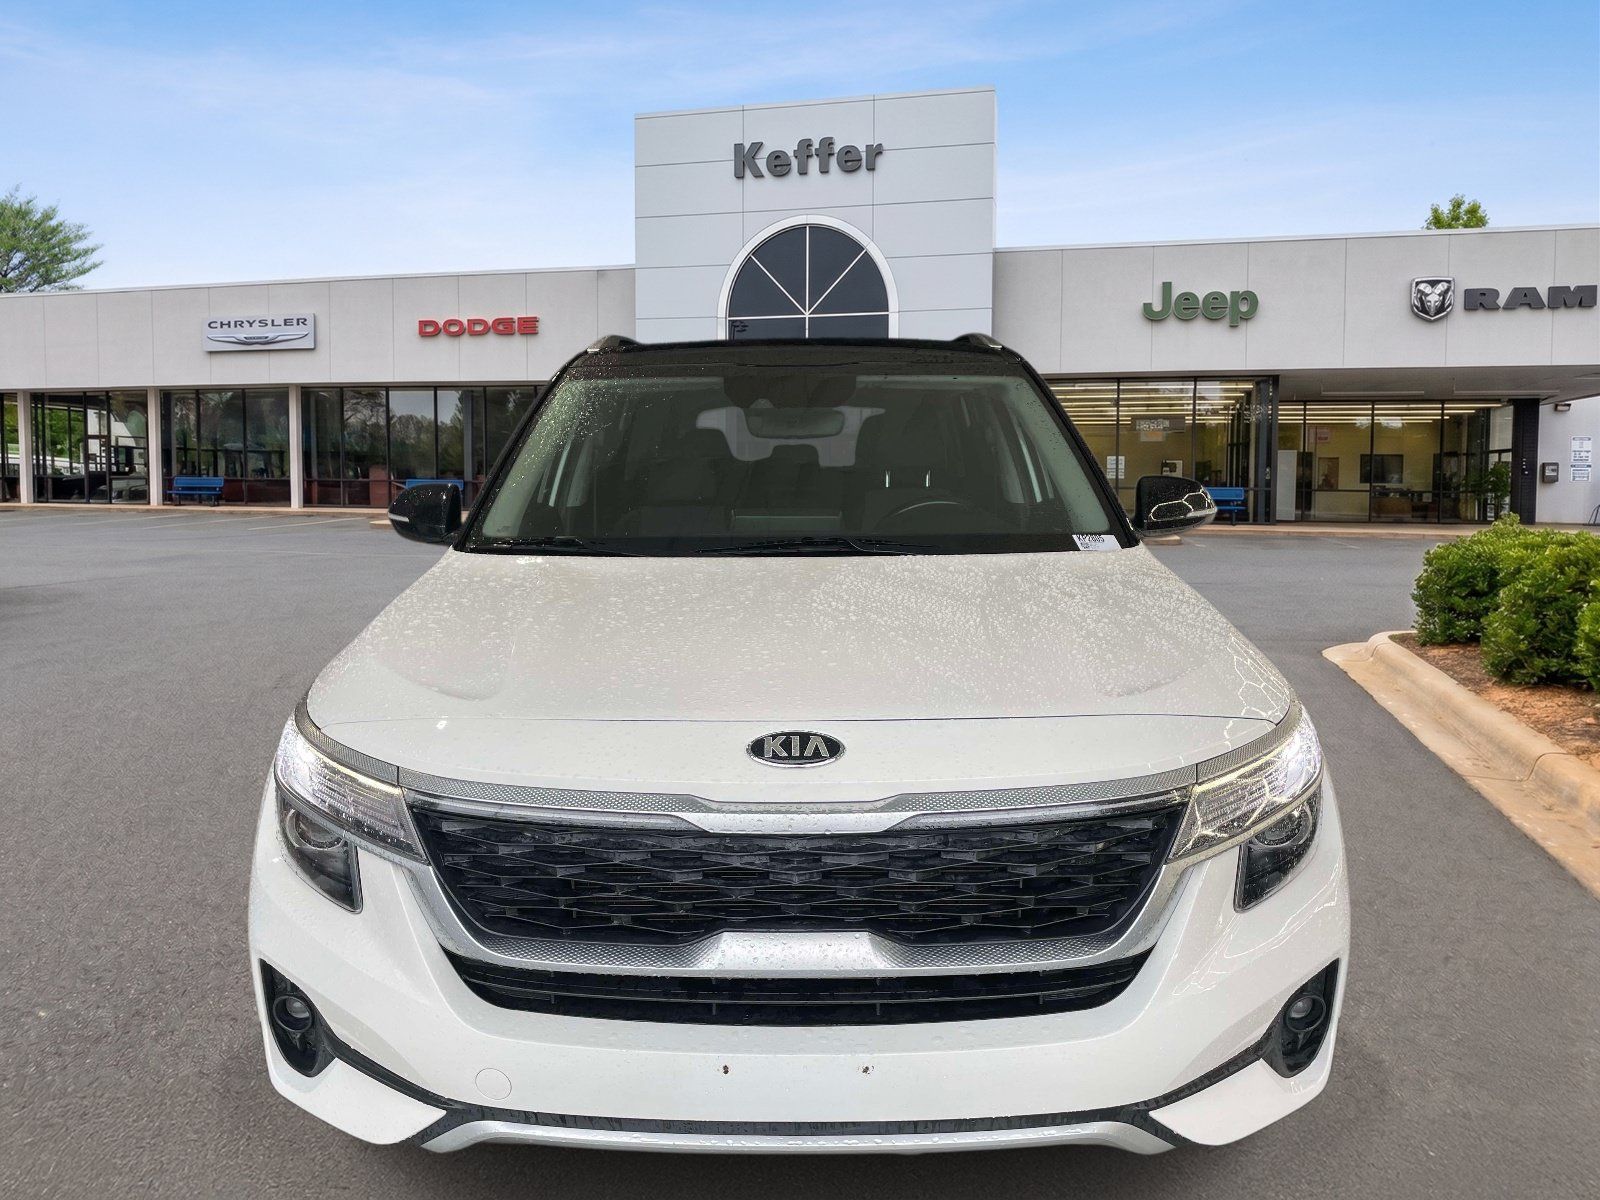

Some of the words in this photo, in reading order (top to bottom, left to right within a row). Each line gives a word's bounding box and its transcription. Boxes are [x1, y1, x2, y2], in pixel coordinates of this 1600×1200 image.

[733, 136, 883, 178] Keffer
[1142, 281, 1259, 328] Jeep
[1464, 284, 1598, 311] RAM
[207, 317, 309, 329] CHRYSLER
[418, 316, 539, 337] DODGE
[763, 735, 830, 758] KIA
